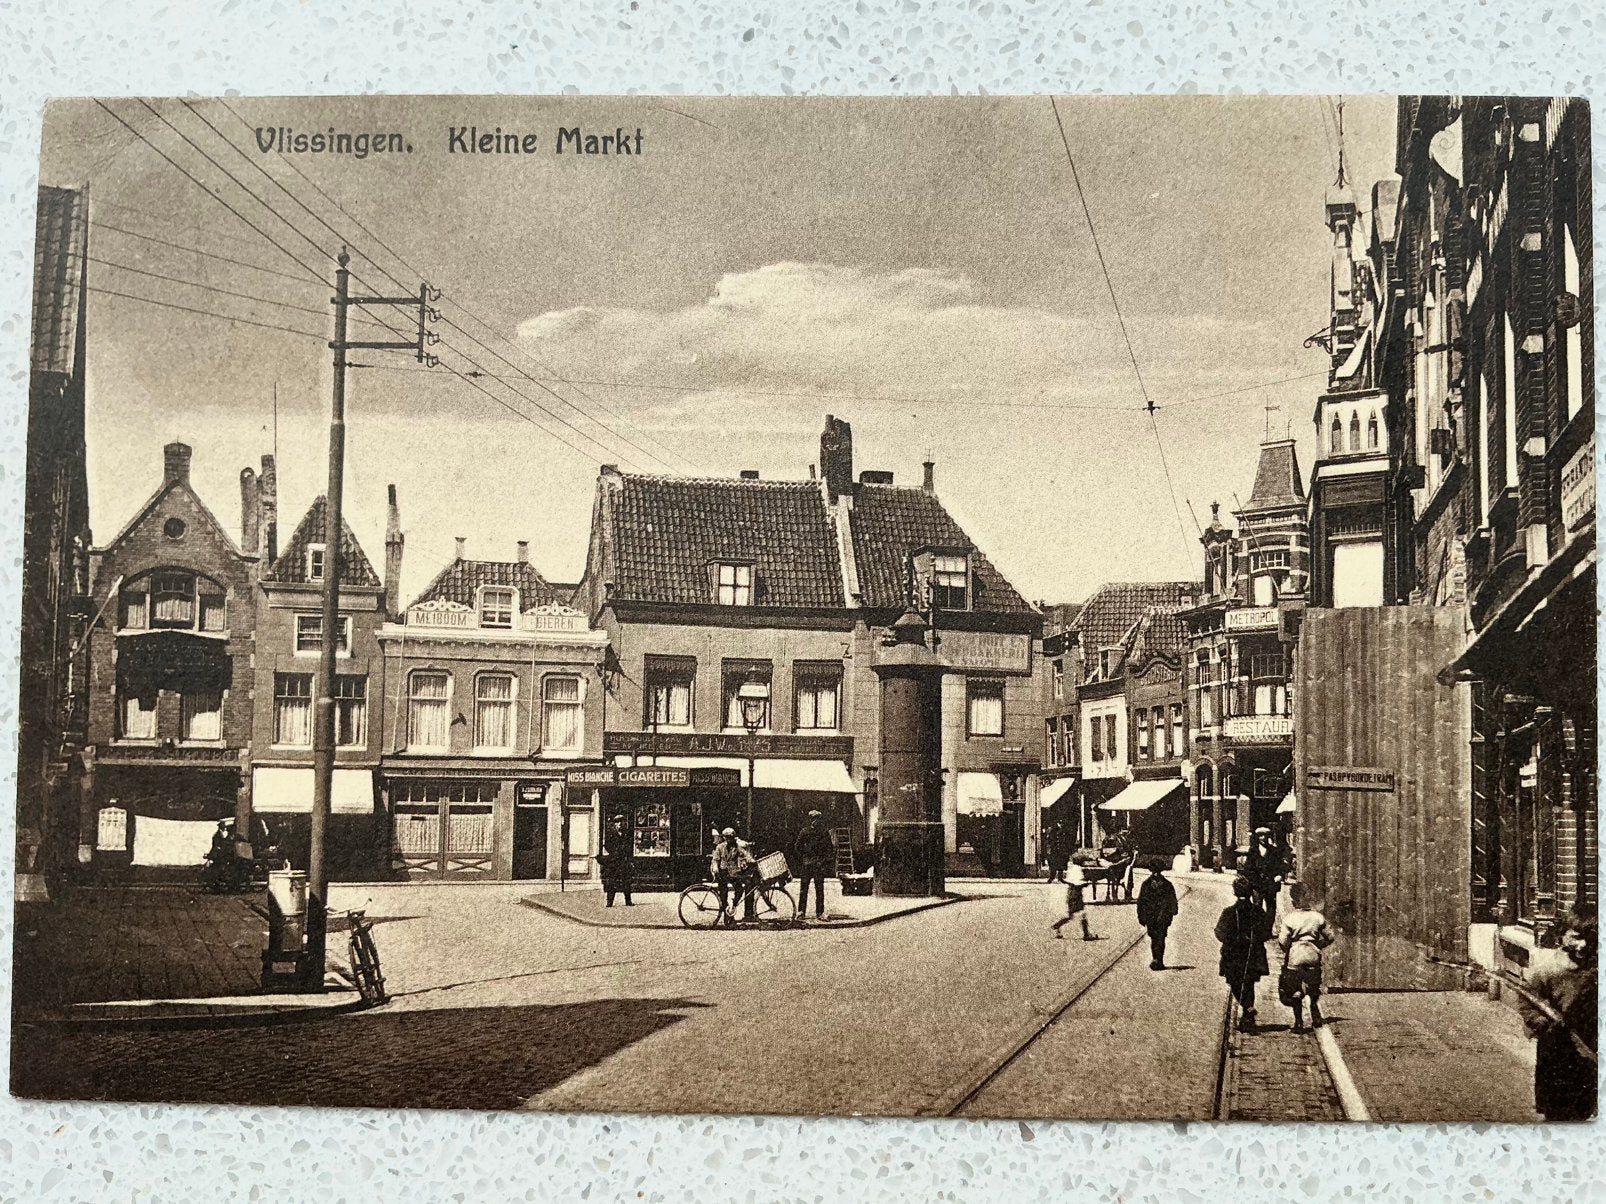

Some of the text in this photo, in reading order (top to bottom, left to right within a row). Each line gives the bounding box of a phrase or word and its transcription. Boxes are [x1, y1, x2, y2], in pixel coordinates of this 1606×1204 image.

[255, 126, 643, 159] Vlissingen. Kleine Markt
[535, 616, 574, 629] BIEREN
[618, 771, 687, 783] CIGARETTES
